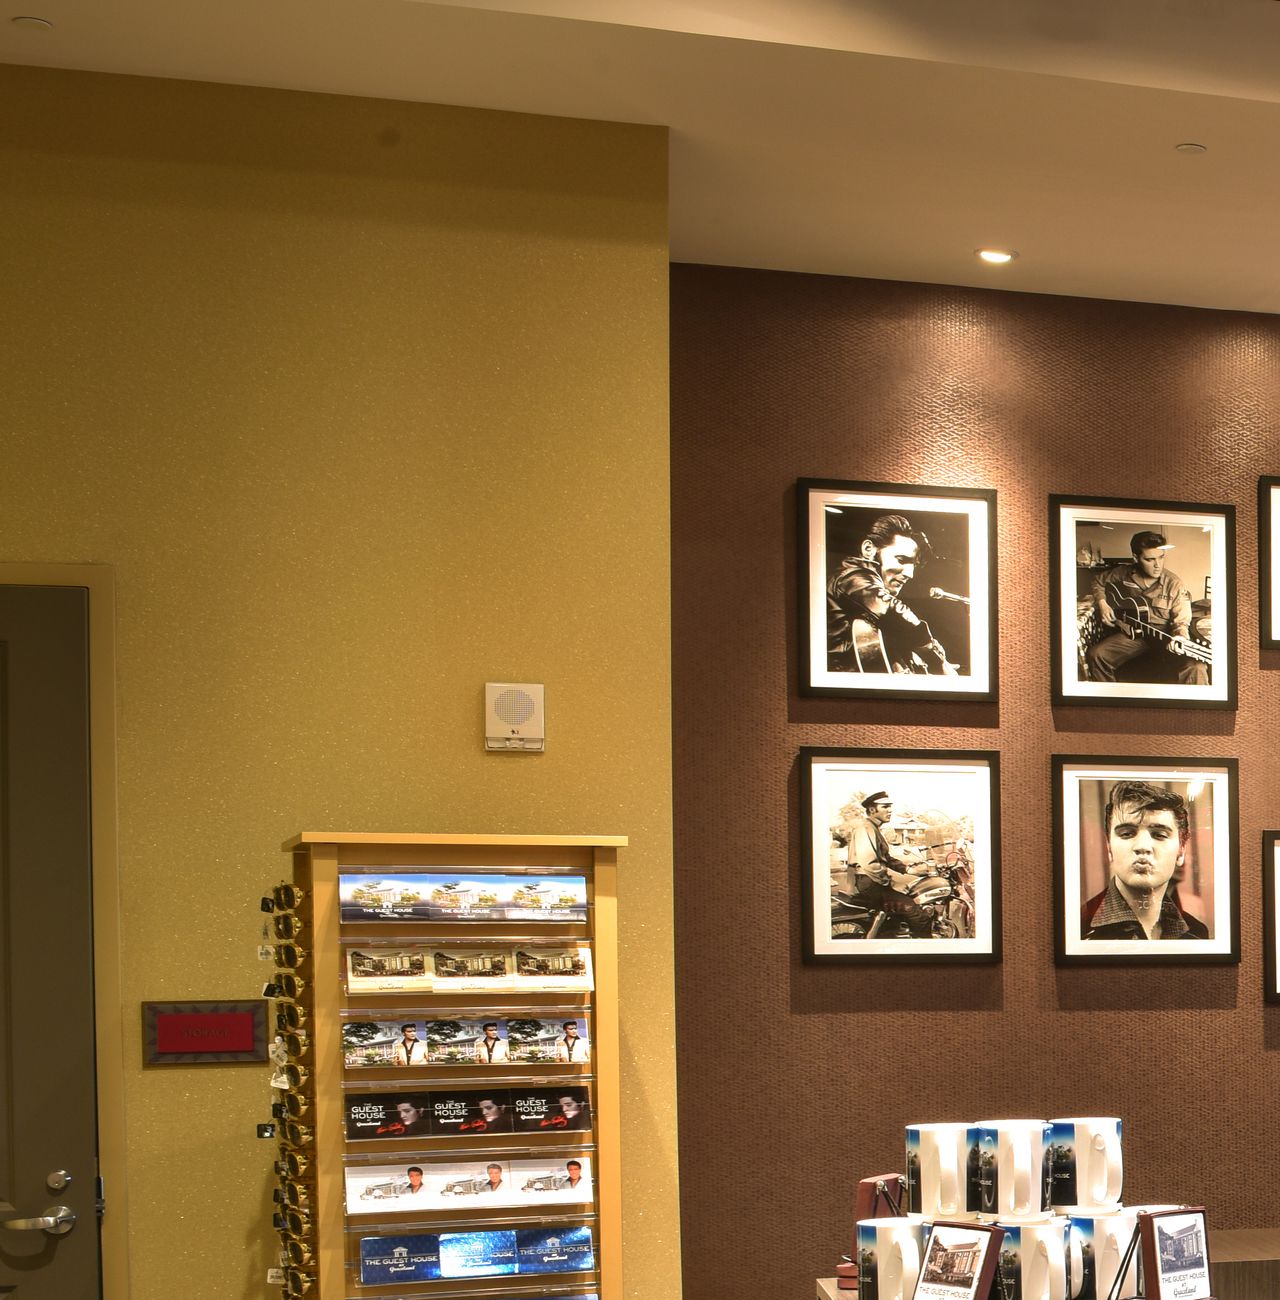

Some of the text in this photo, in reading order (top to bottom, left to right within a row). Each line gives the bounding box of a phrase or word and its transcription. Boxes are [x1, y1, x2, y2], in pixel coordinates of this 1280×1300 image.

[434, 1102, 467, 1110] GUEST
[515, 1099, 547, 1107] GUEST
[351, 1105, 384, 1113] GUEST
[515, 1105, 549, 1113] HOUSE
[351, 1111, 386, 1119] HOUSE
[536, 1247, 562, 1255] GUEST
[563, 1245, 590, 1253] HOUSE
[382, 1257, 409, 1265] GUEST
[410, 1255, 439, 1263] HOUSE
[1172, 1274, 1188, 1282] GUEST
[1189, 1271, 1206, 1280] HOUSE
[919, 1286, 971, 1300] THE GUEST HOUSE
